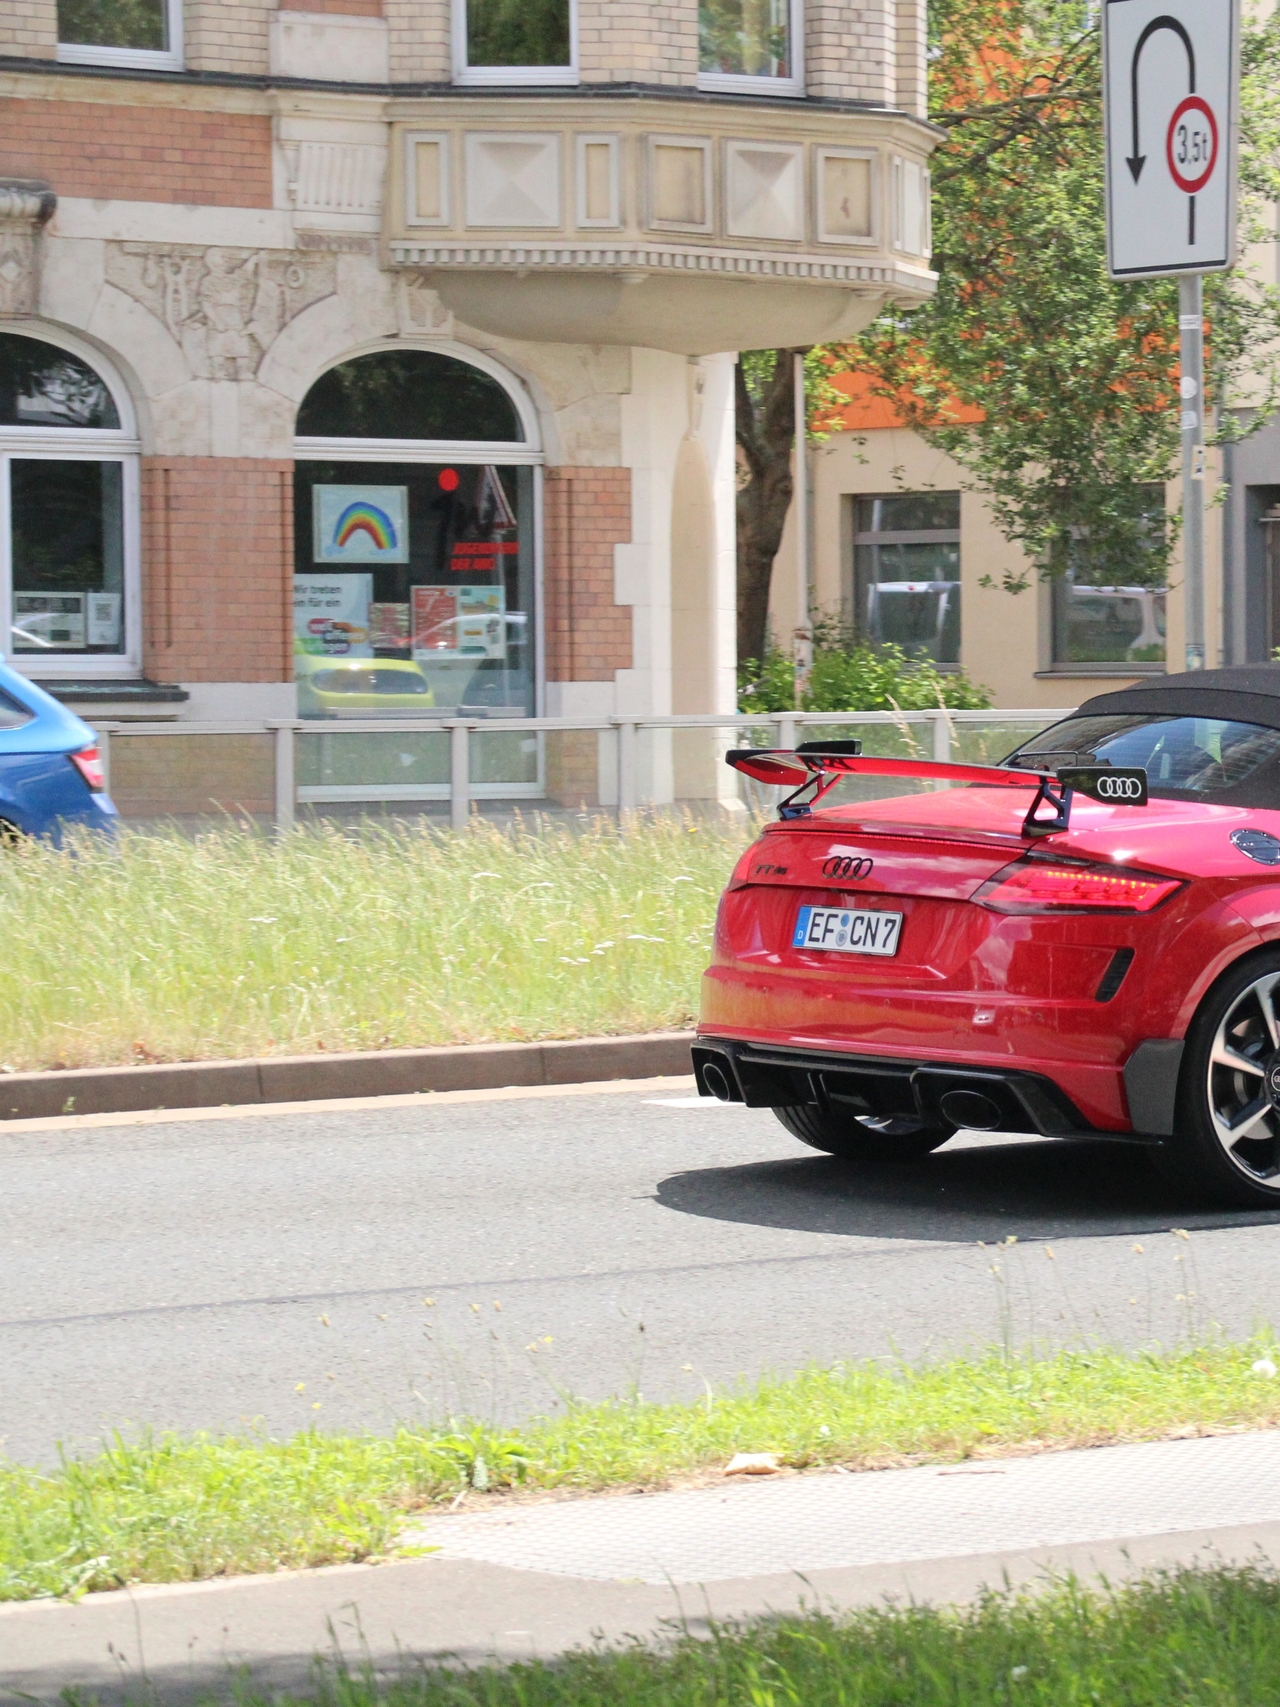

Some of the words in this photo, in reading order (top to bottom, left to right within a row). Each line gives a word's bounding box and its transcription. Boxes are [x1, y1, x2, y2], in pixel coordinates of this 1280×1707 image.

[1177, 124, 1207, 164] 3,5t
[797, 930, 804, 940] D
[808, 912, 839, 943] EF
